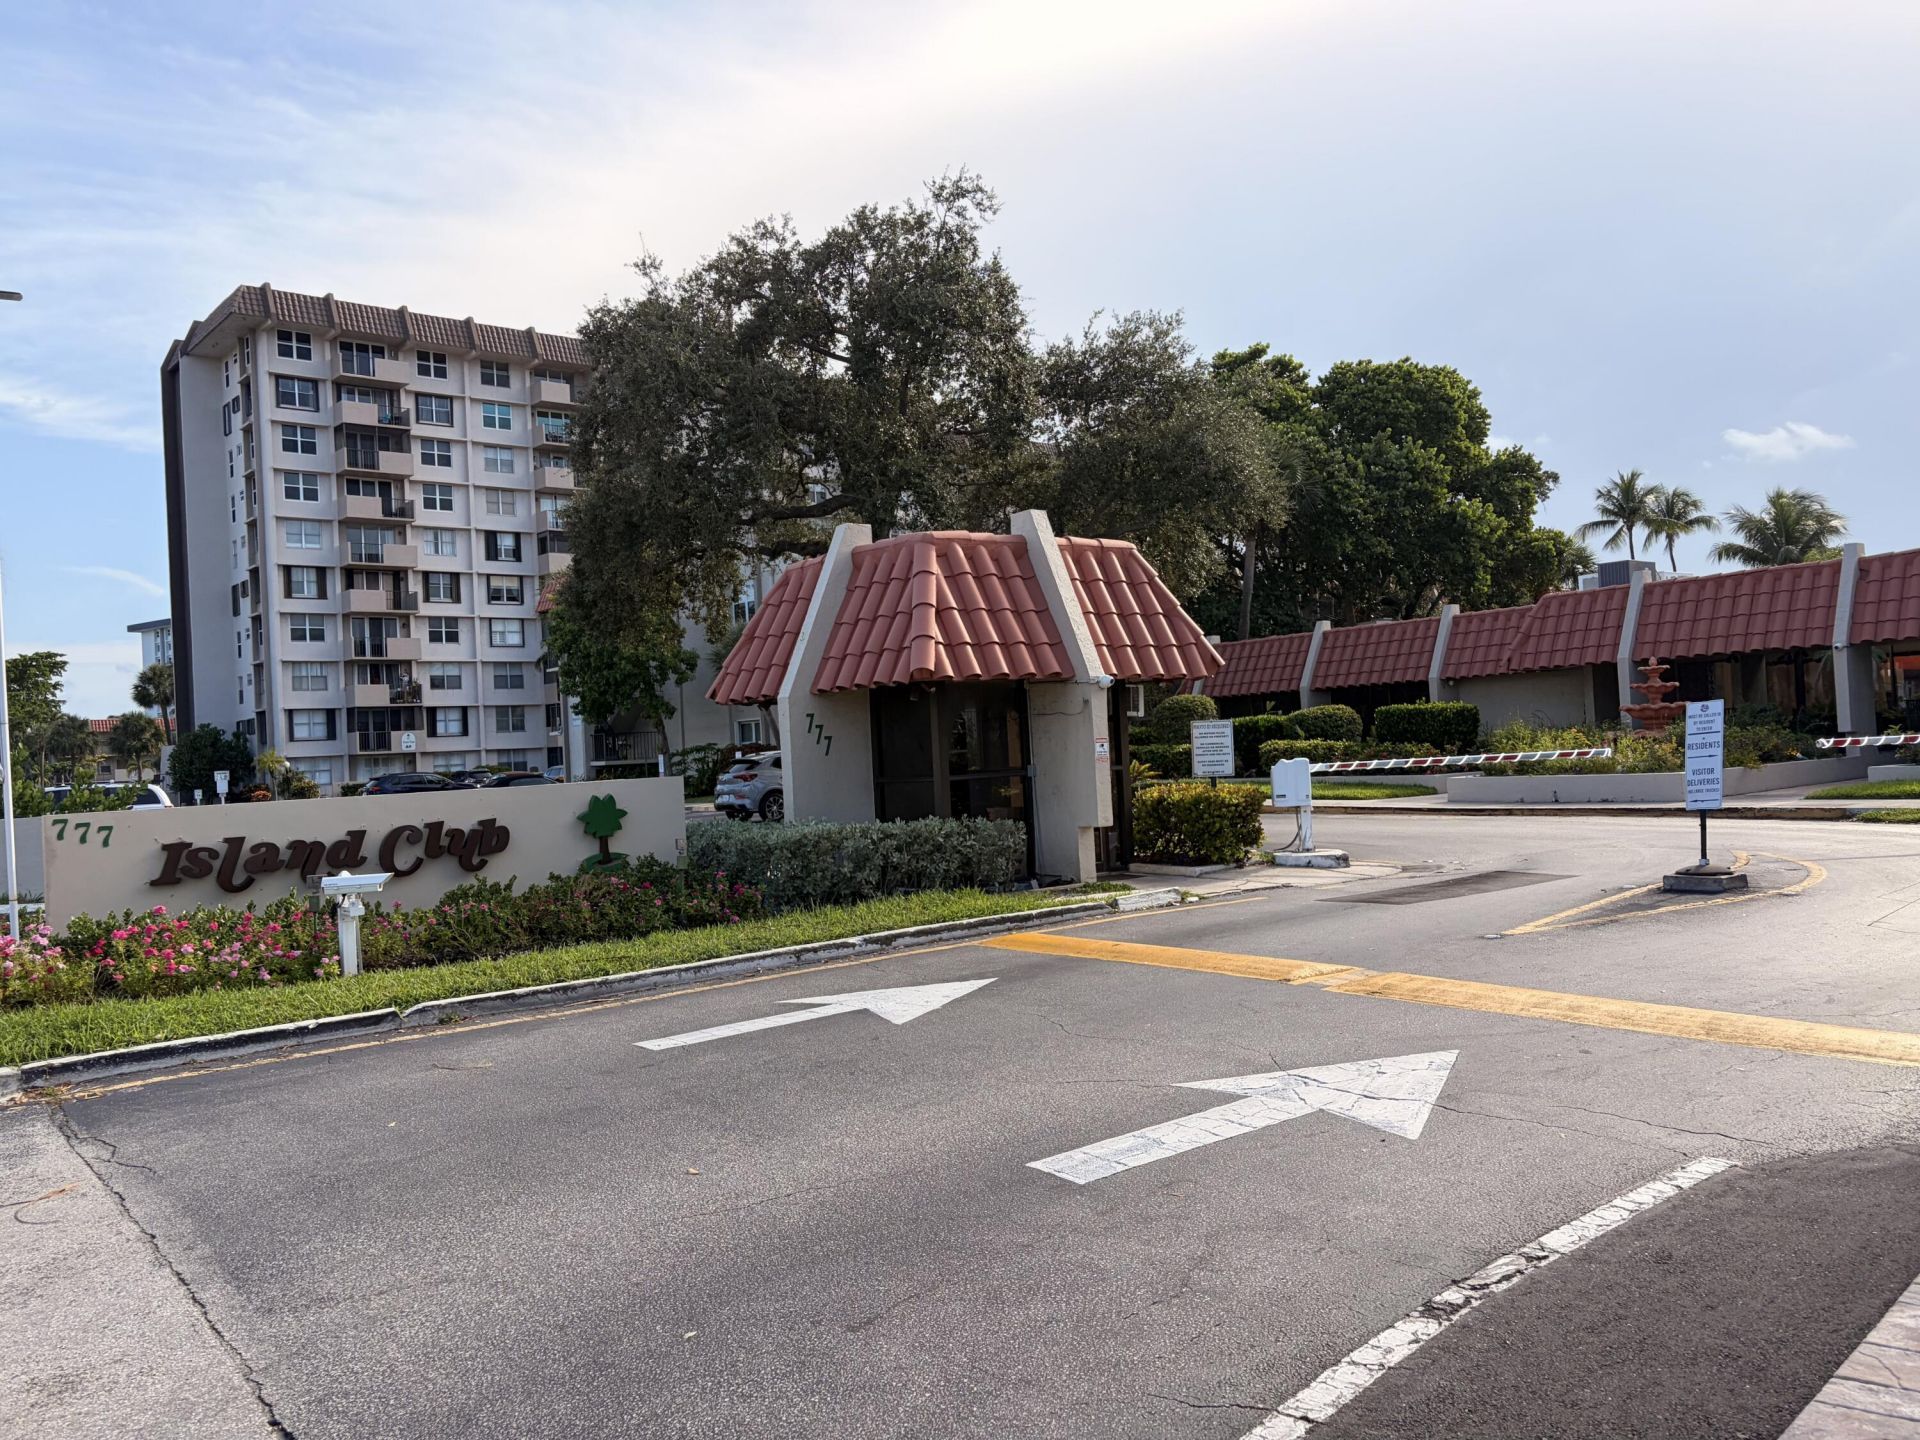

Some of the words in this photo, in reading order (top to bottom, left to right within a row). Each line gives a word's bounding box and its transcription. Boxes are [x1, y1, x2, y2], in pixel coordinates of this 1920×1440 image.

[805, 713, 833, 757] 777
[1687, 741, 1720, 751] RESIDENTS
[1691, 767, 1715, 776] VISITOR
[1687, 778, 1720, 787] DELIVERIES
[51, 818, 114, 849] 777
[149, 828, 367, 894] Island
[379, 817, 511, 878] Club
